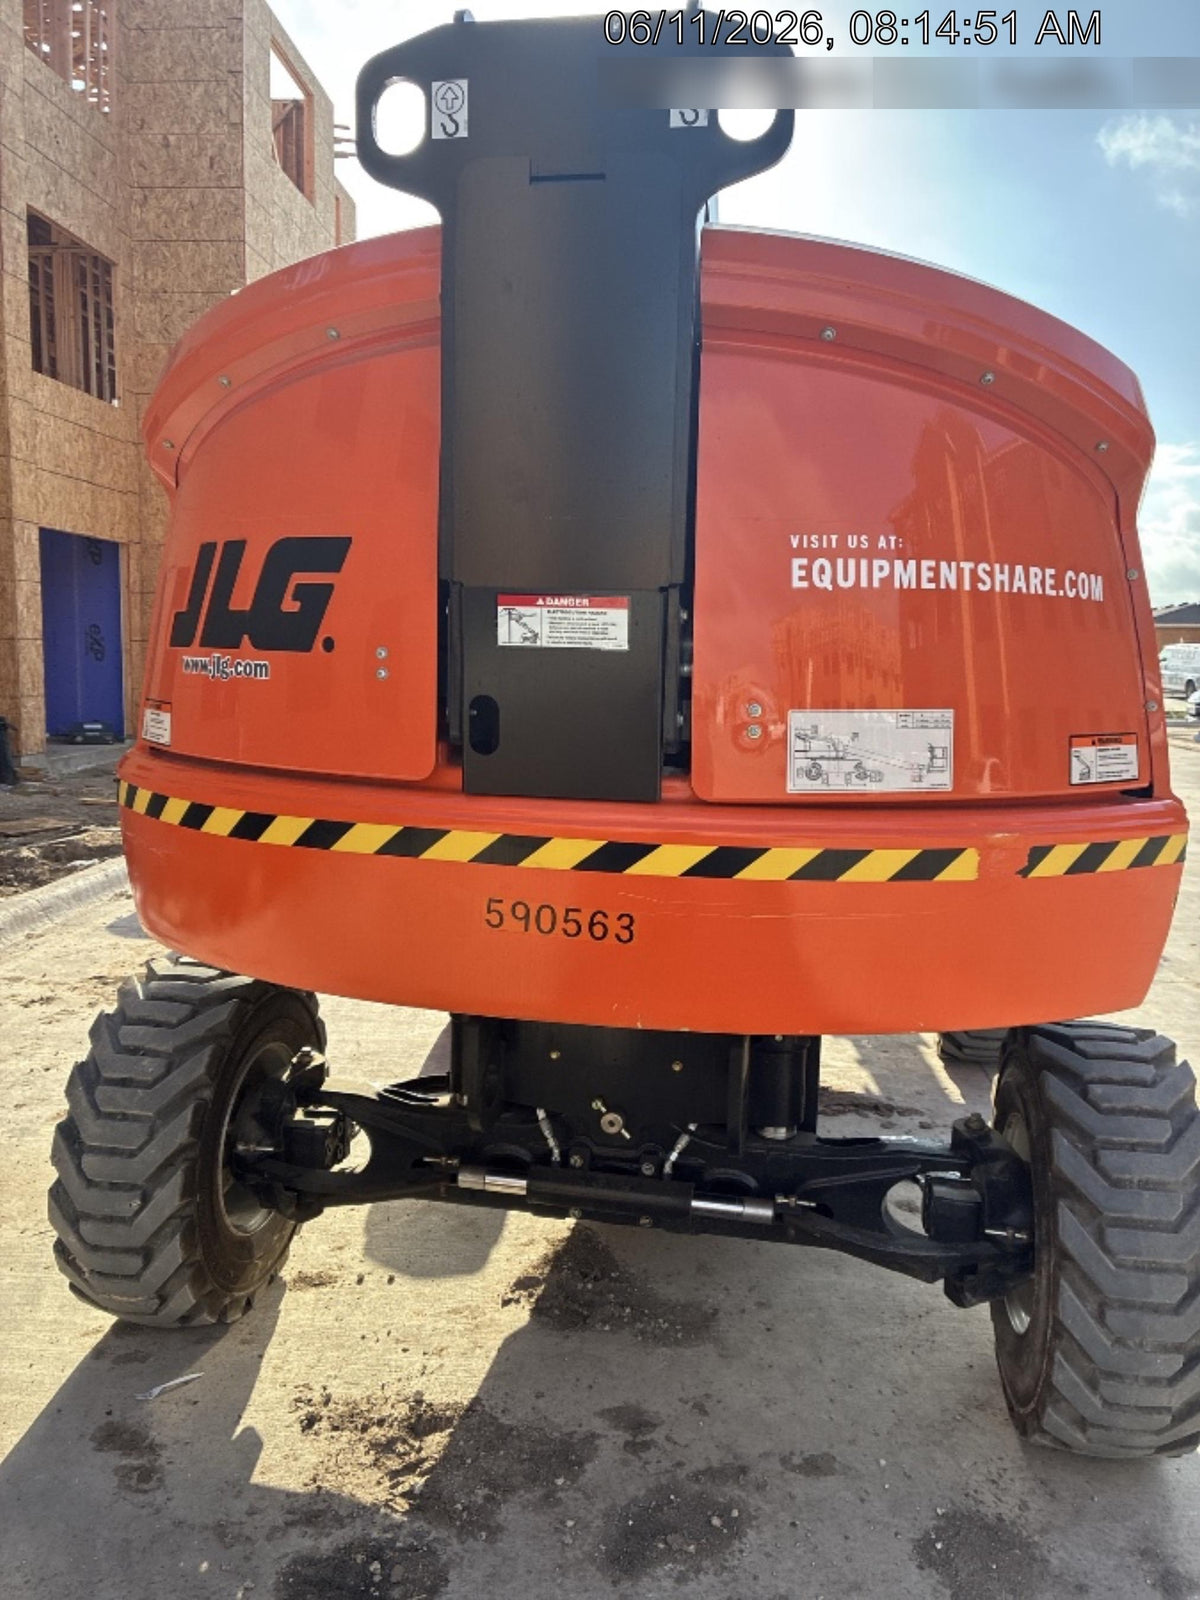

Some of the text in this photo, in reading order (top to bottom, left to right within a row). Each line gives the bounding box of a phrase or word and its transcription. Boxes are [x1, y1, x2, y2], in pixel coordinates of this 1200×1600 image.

[790, 534, 903, 550] VISIT US AT:
[791, 557, 1104, 602] EQUIPMENTSHARE.COM
[545, 597, 590, 607] DANGER
[183, 655, 269, 679] www.jlg.com
[485, 898, 634, 944] 590563
